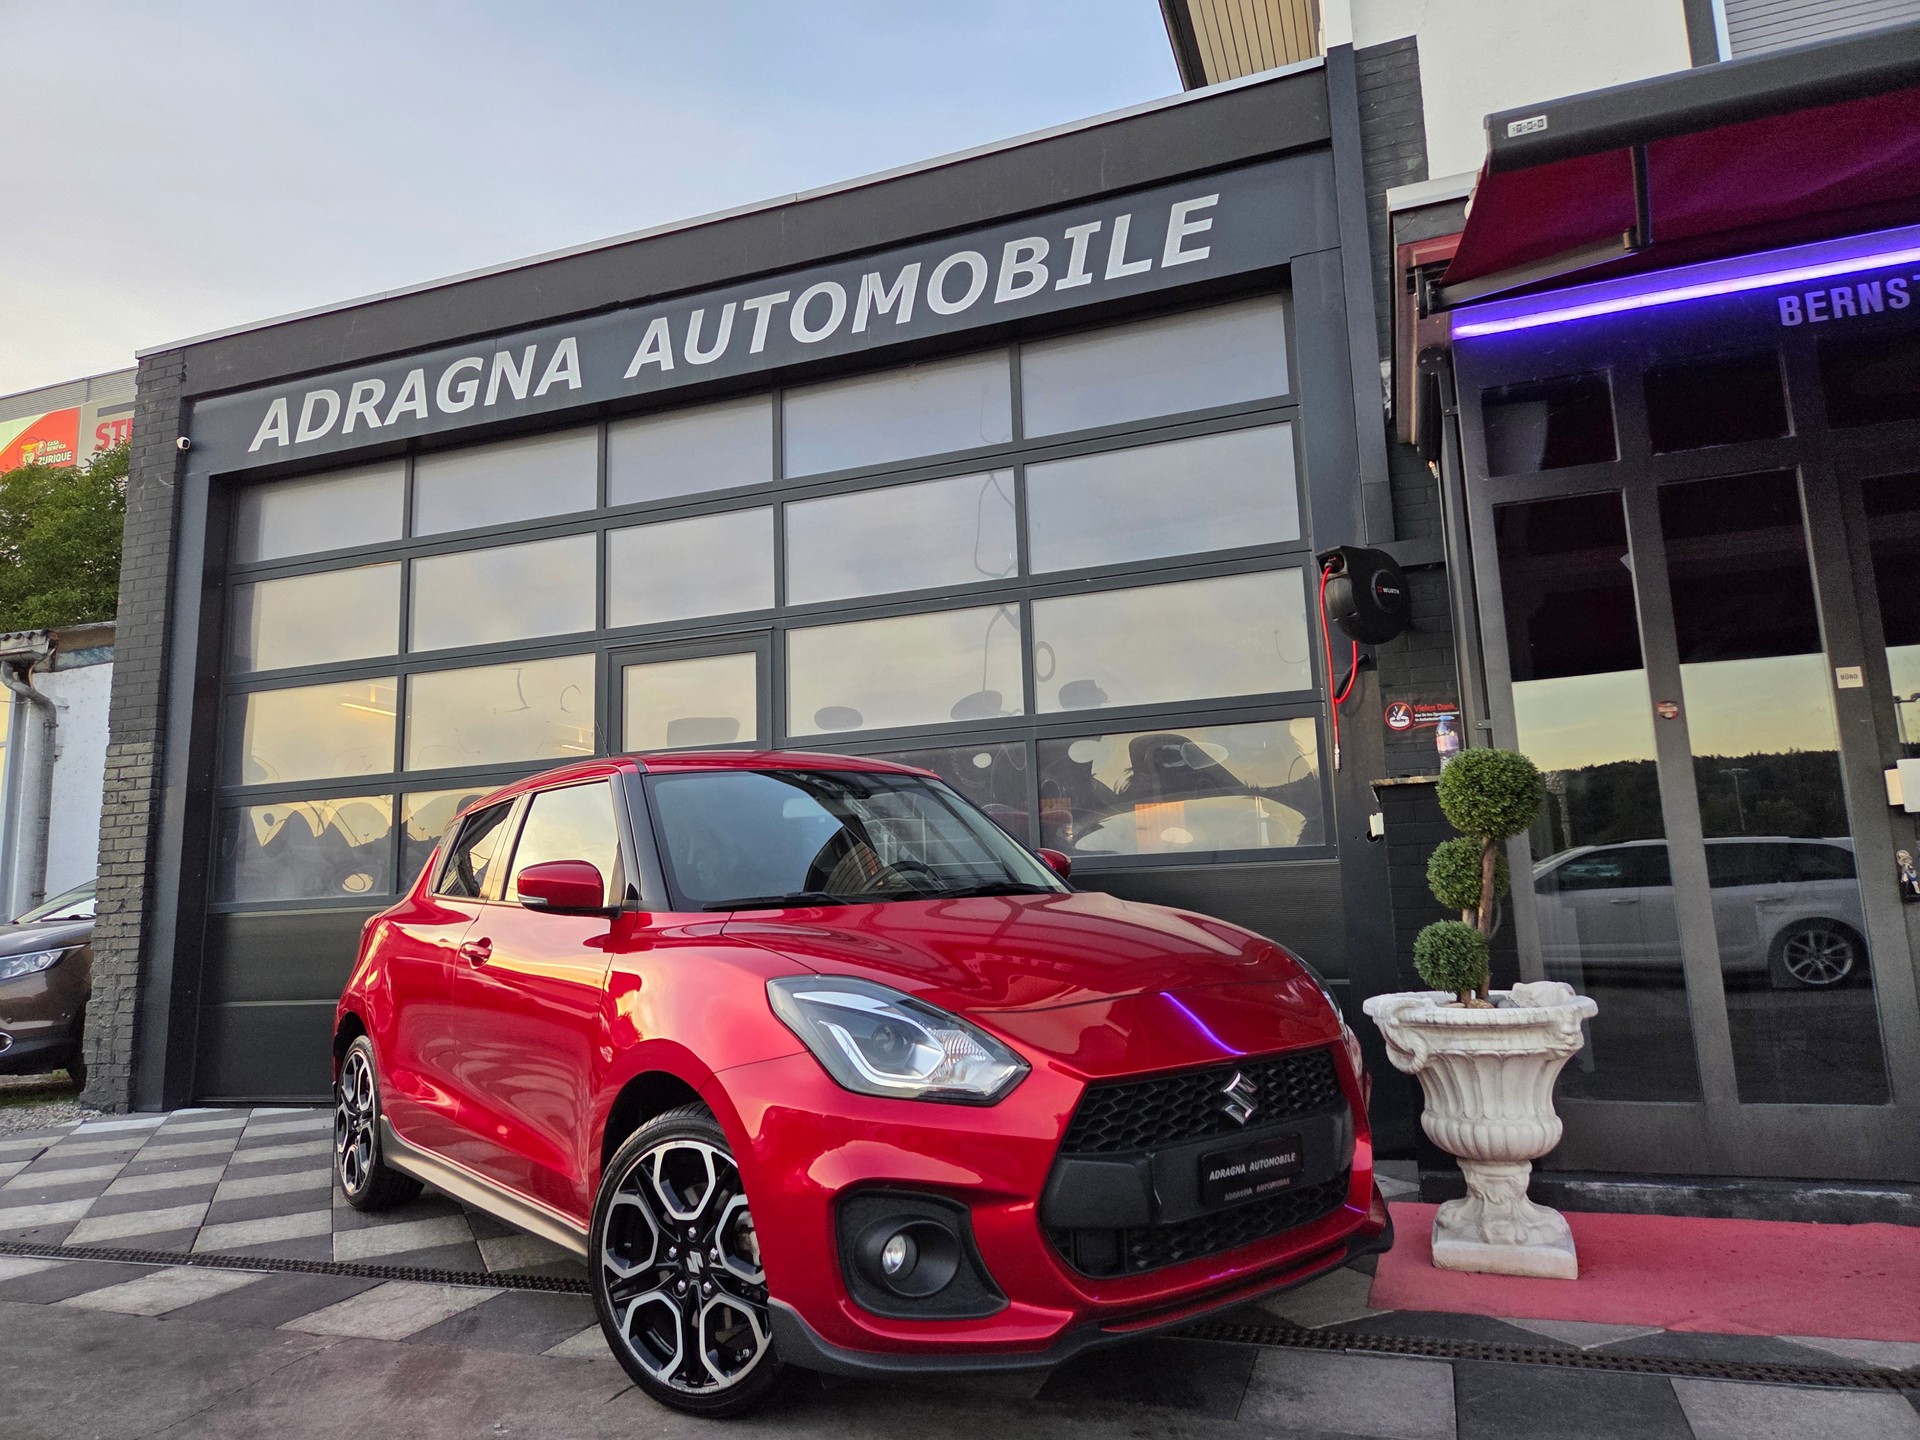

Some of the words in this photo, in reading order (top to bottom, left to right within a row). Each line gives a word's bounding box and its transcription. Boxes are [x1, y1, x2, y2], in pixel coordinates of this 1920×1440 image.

[247, 336, 582, 453] ADRAGNA
[622, 193, 1220, 380] AUTOMOBILE
[37, 451, 72, 466] ZURIQUE
[1209, 1163, 1247, 1181] ADRAGNA
[1249, 1152, 1296, 1172] AUTOMOBILE
